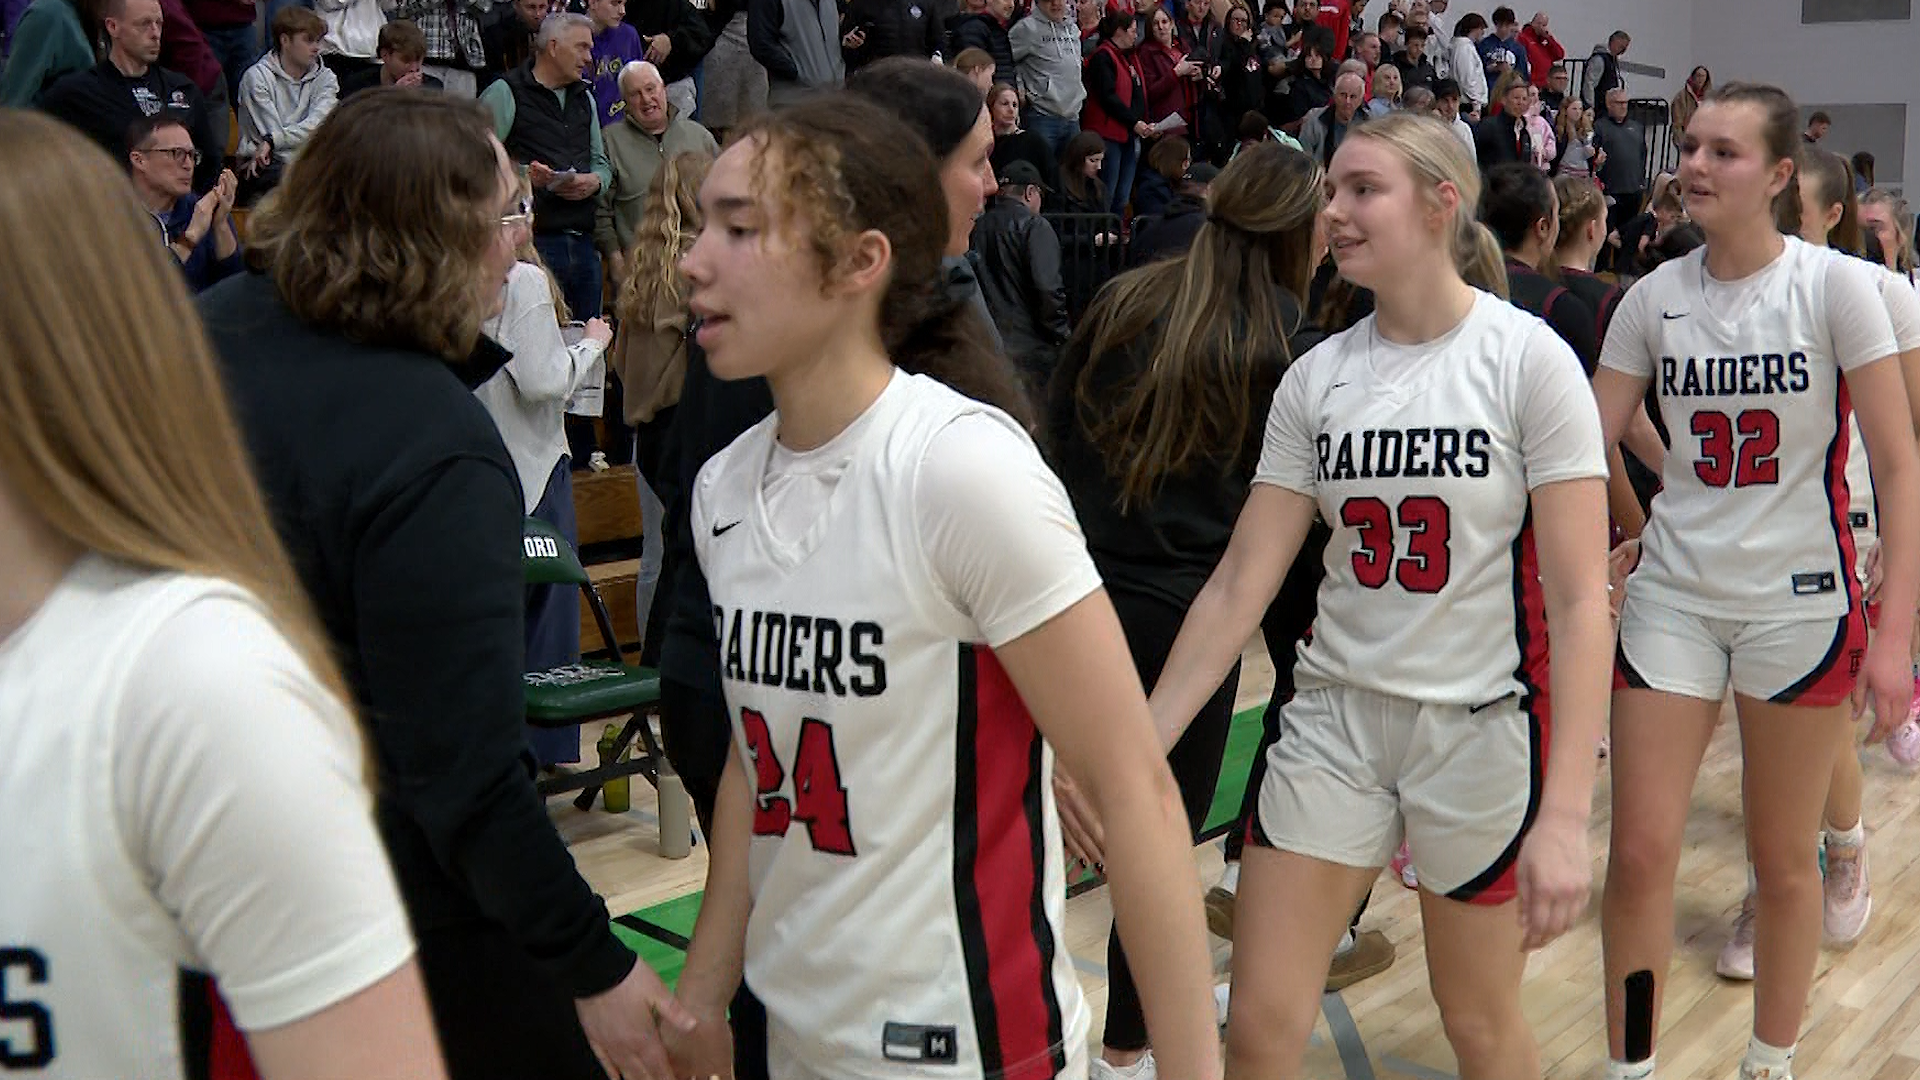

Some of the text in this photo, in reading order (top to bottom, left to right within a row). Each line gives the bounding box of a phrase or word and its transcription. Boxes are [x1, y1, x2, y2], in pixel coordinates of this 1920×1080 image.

[1661, 351, 1809, 396] RAIDERS
[1316, 427, 1491, 481] RAIDERS
[1690, 408, 1780, 488] 32
[1340, 495, 1450, 593] 33
[740, 706, 857, 857] 24
